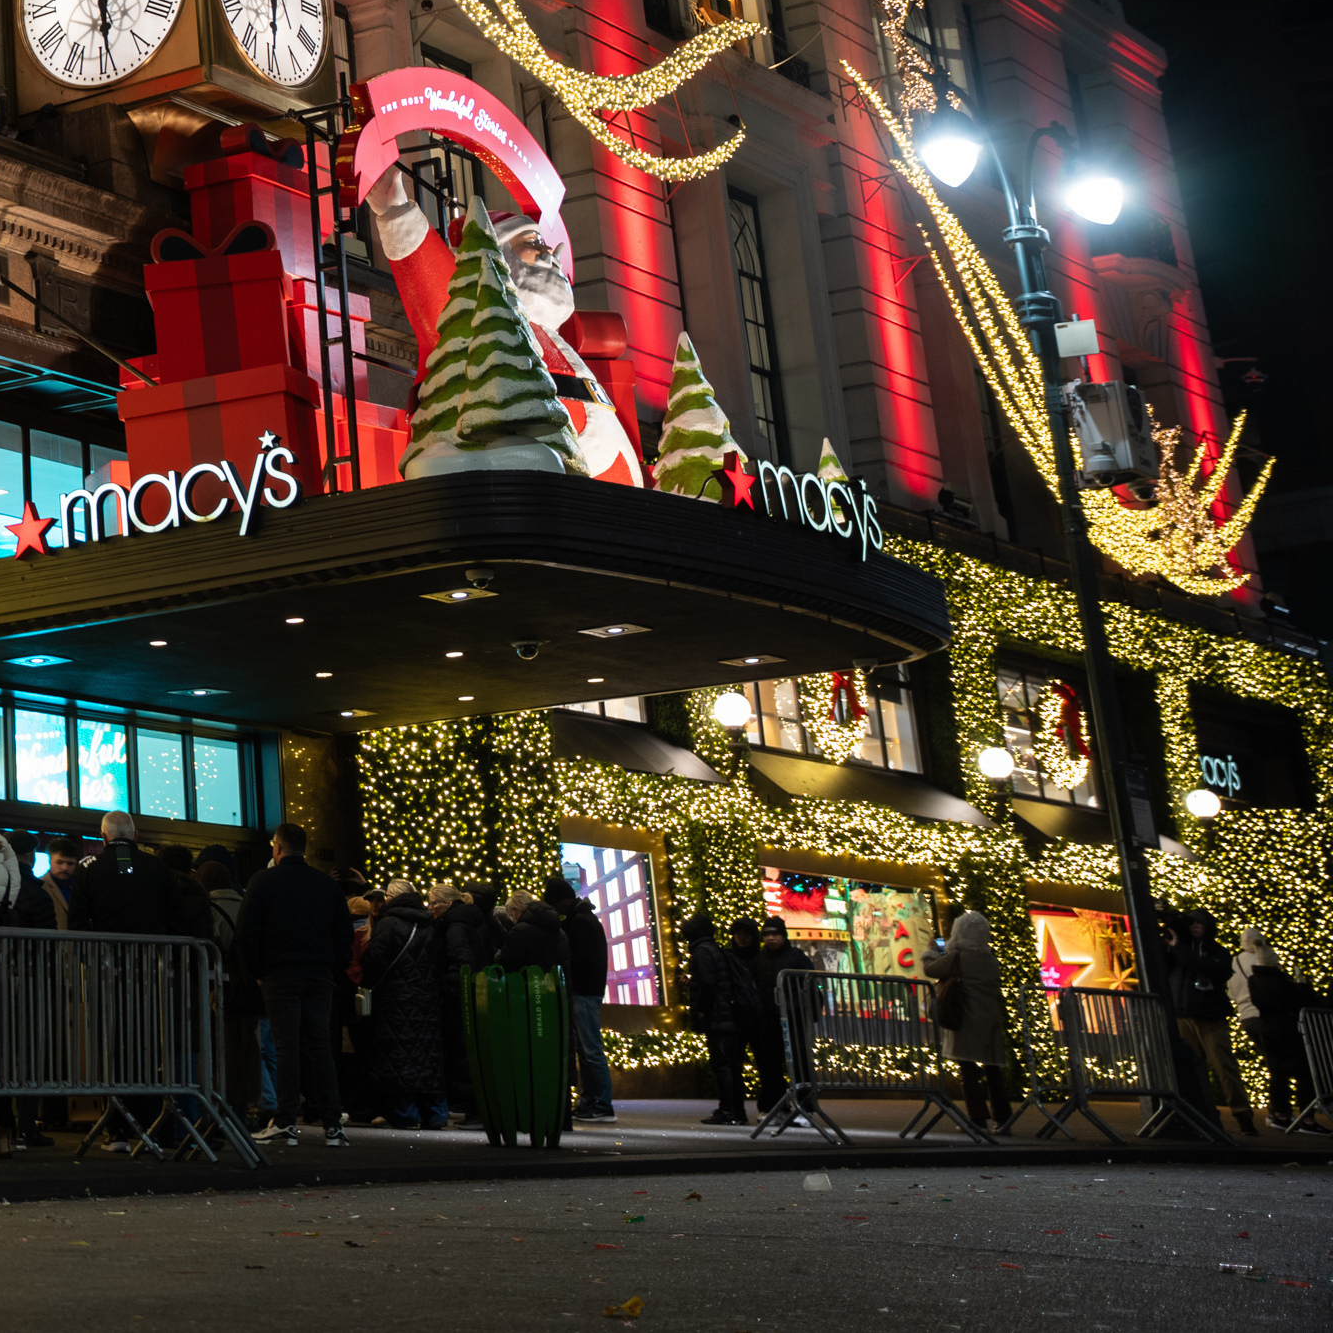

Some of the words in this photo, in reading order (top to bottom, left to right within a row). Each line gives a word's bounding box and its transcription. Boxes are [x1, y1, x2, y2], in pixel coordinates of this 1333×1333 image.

[380, 101, 398, 115] THE
[401, 95, 425, 107] MOST
[424, 86, 475, 120] Wonderful
[474, 108, 508, 145] Stories
[508, 139, 533, 170] START
[533, 974, 542, 1006] SQUARE
[536, 1006, 544, 1037] HERALD
